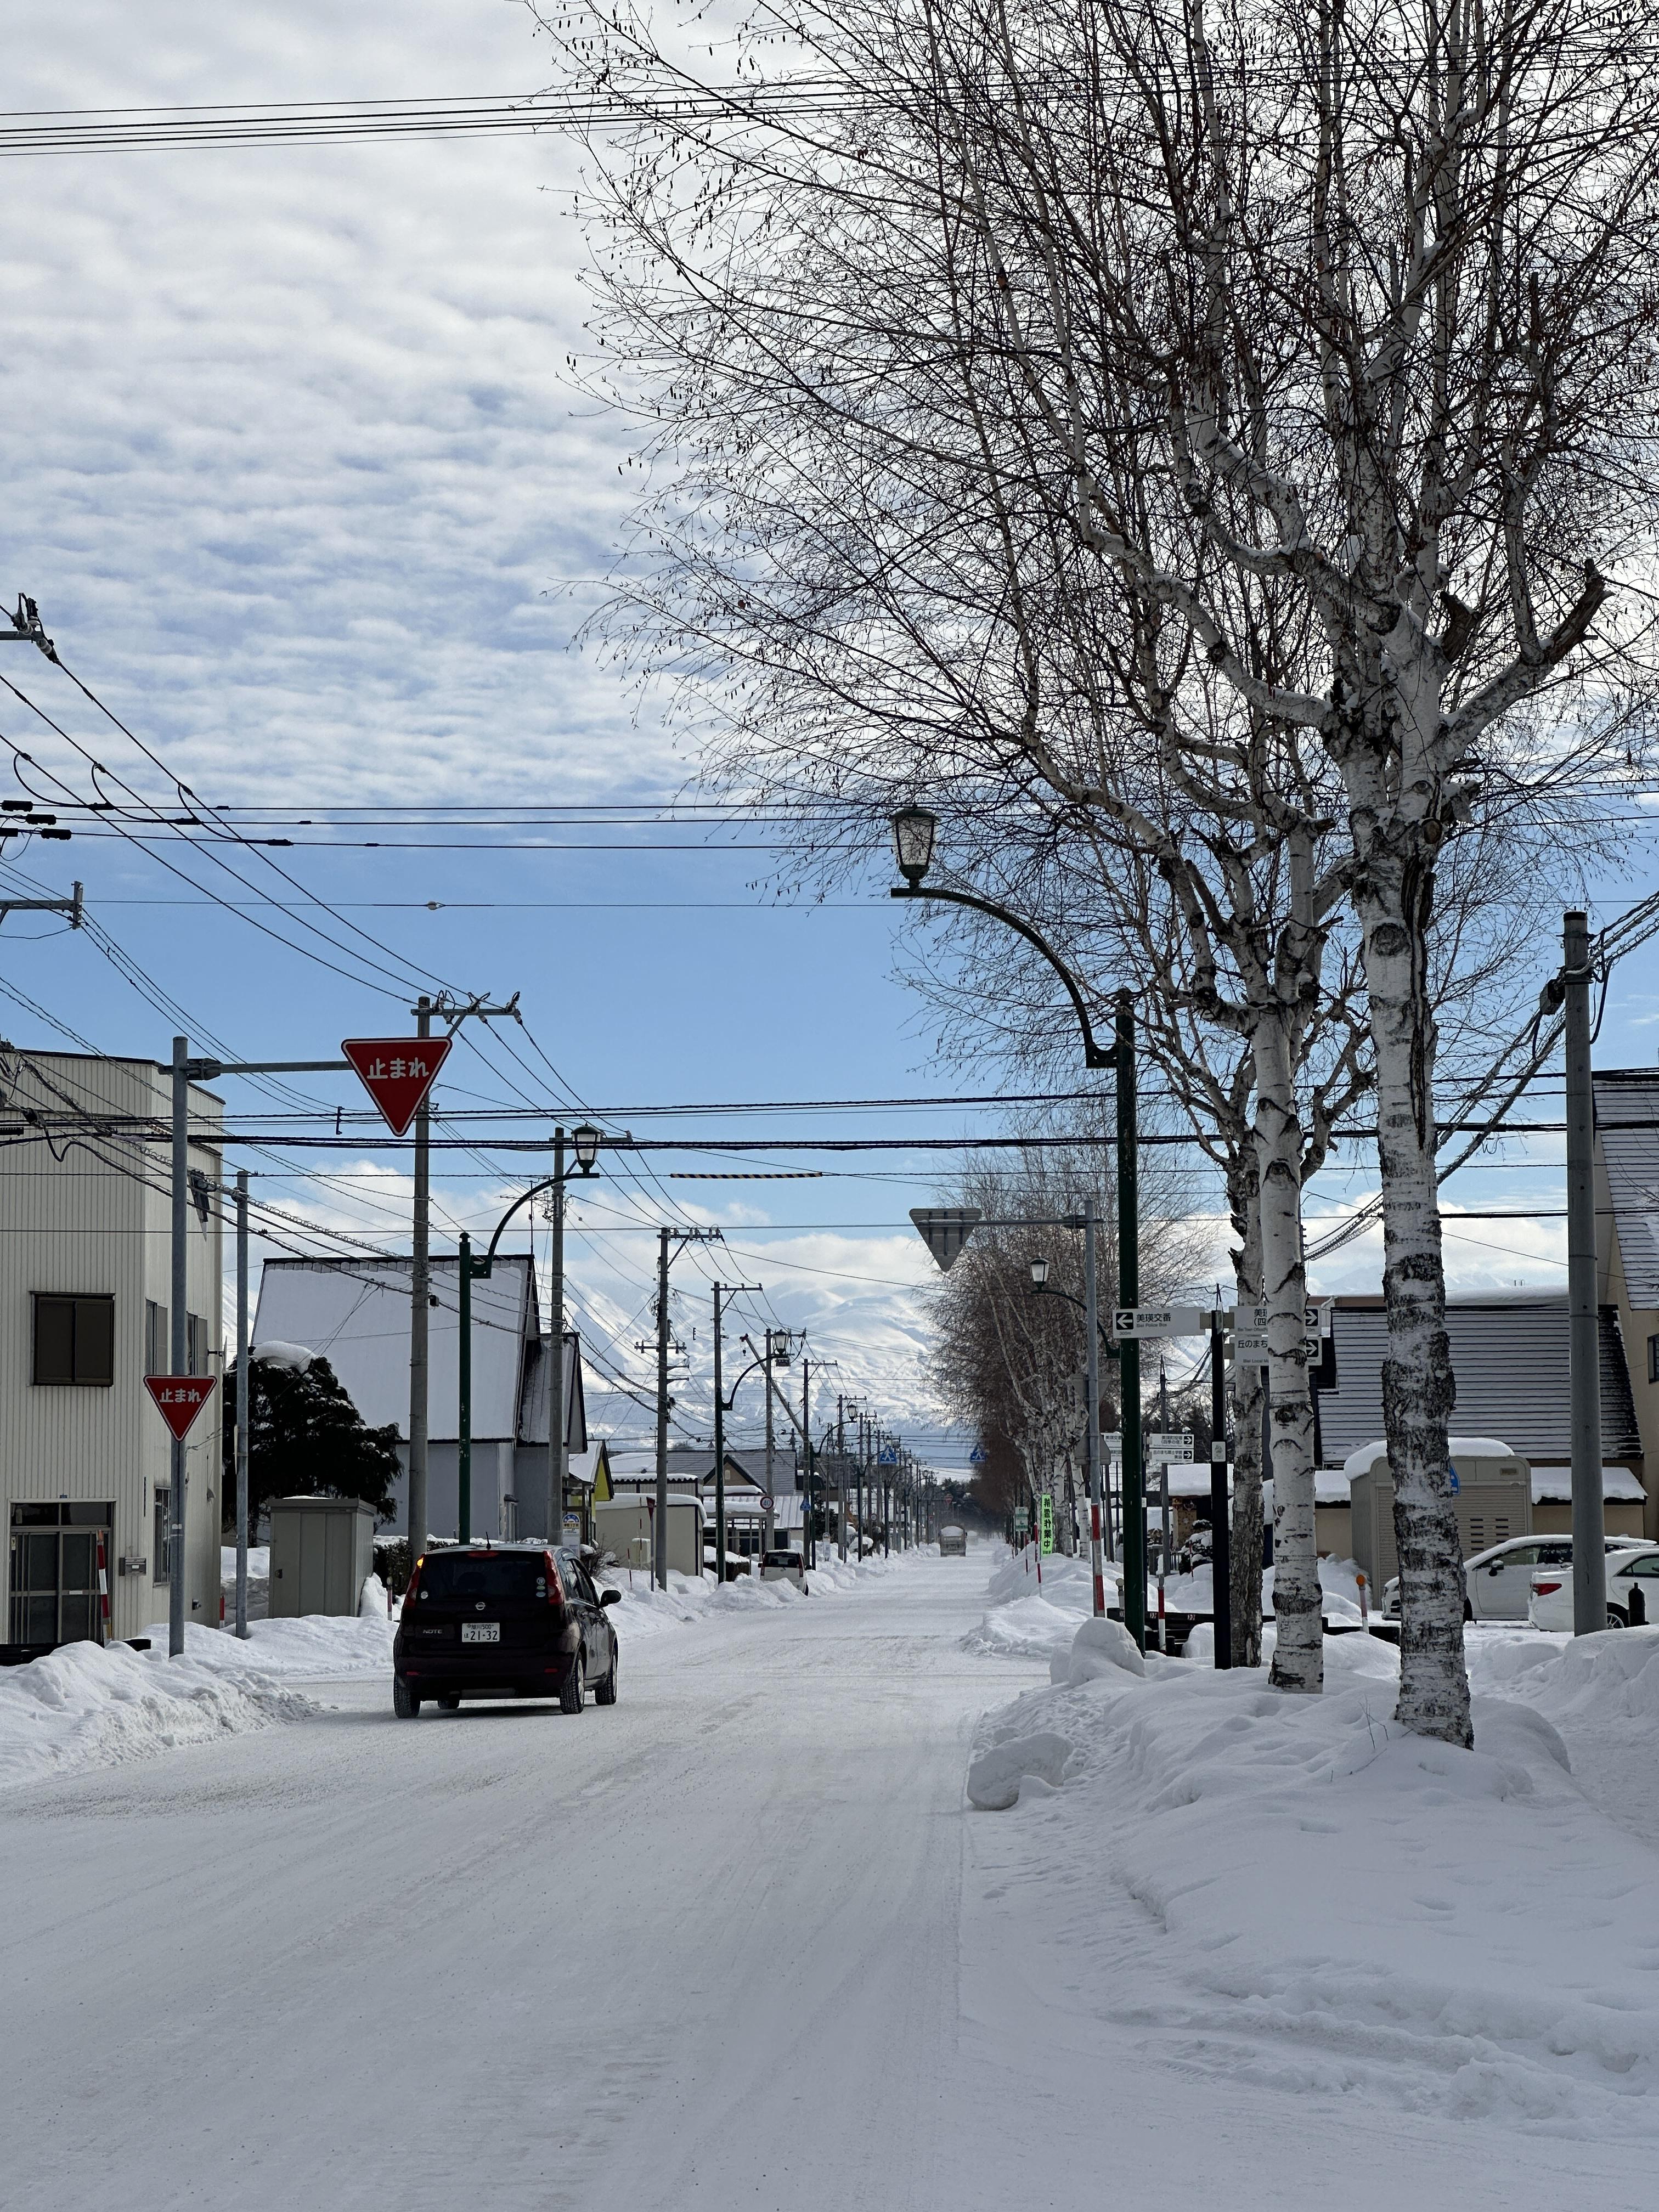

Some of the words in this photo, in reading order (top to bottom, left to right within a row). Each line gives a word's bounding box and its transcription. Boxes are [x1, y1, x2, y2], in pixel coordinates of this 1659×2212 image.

[366, 1057, 430, 1079] 止まれ
[1136, 1312, 1172, 1323] 美瑛交番
[1237, 1340, 1268, 1348] 丘のまち
[159, 1388, 201, 1403] 止まれ
[470, 1630, 498, 1640] 21-32
